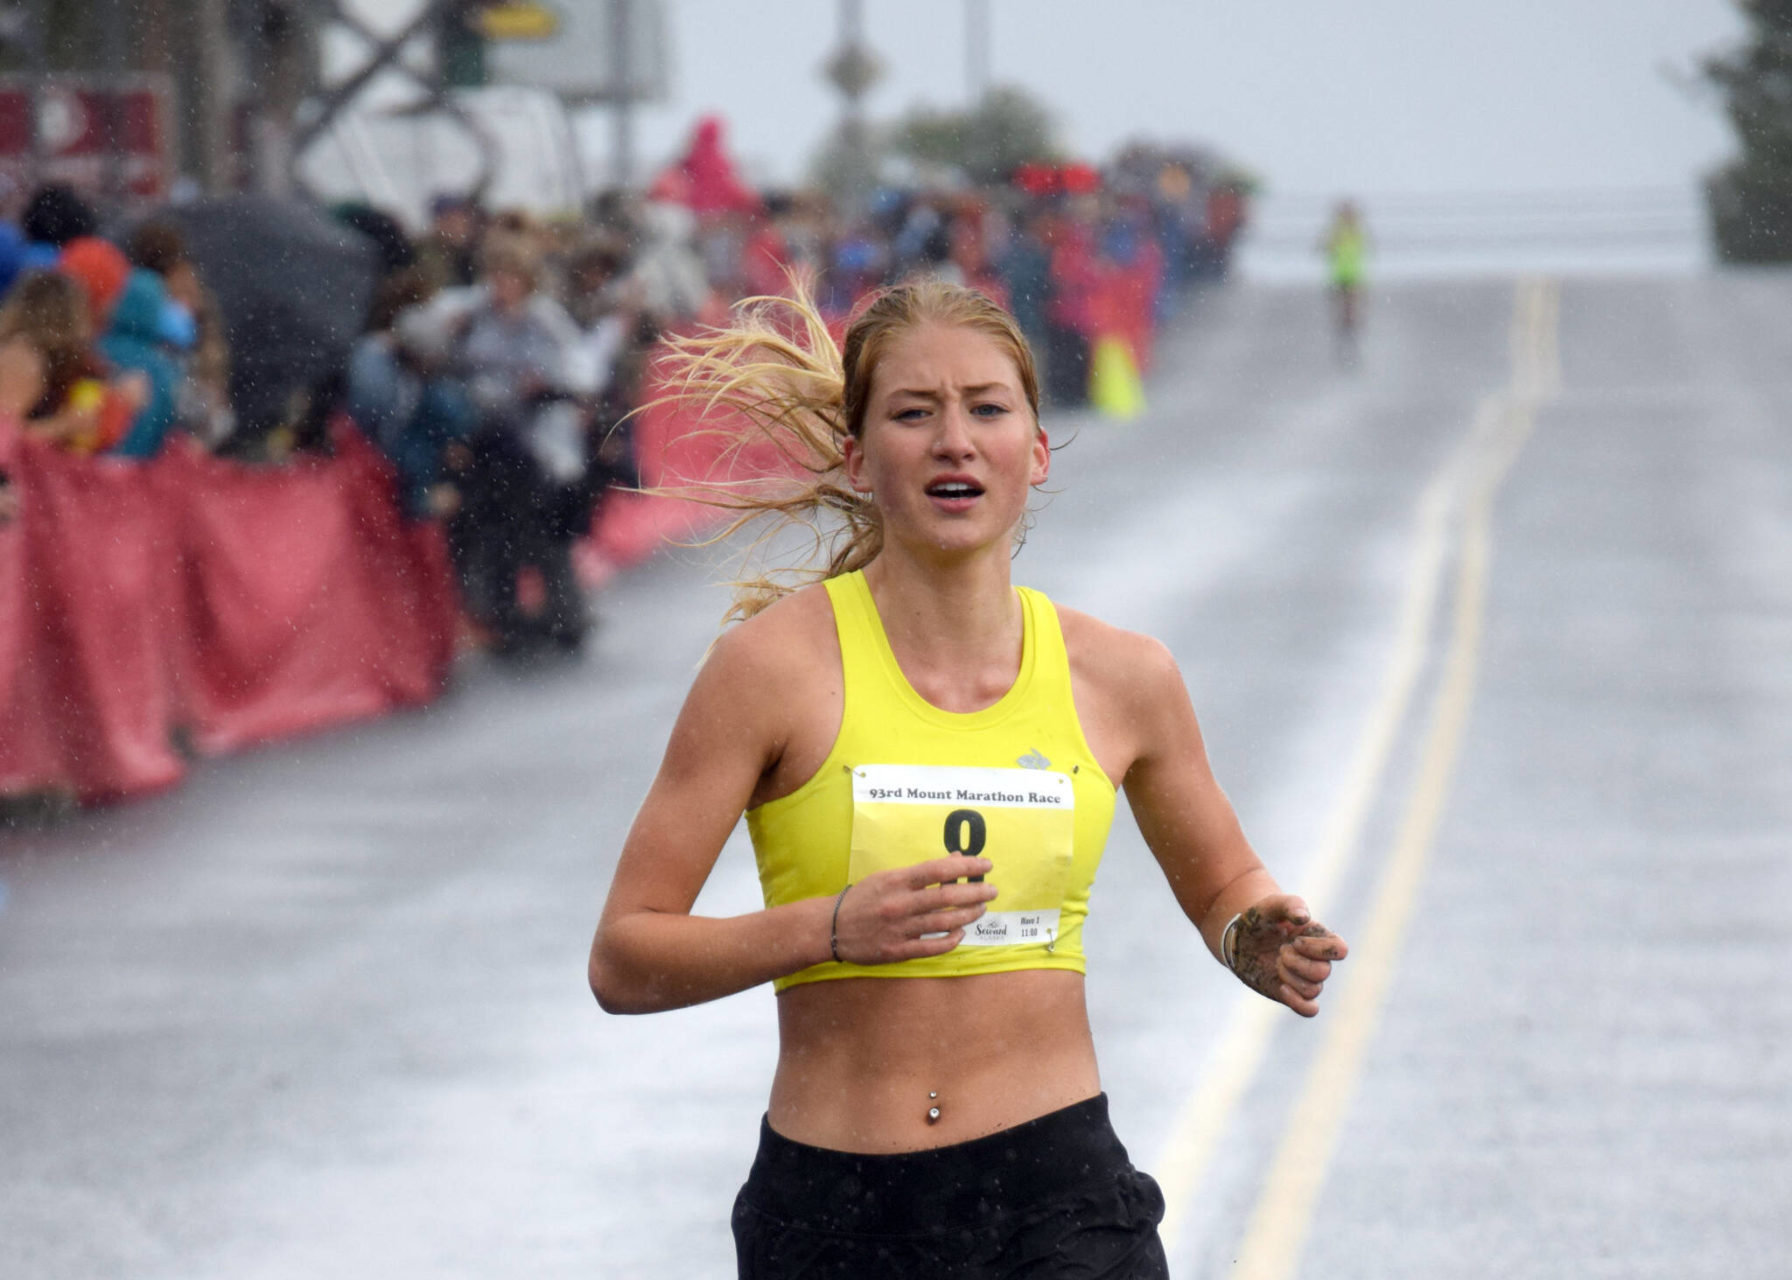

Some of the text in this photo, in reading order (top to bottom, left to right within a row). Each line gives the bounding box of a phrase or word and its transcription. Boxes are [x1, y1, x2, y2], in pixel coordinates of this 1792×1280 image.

[869, 788, 1061, 803] 93rd Mount Marathon Race
[975, 924, 1008, 936] Seward
